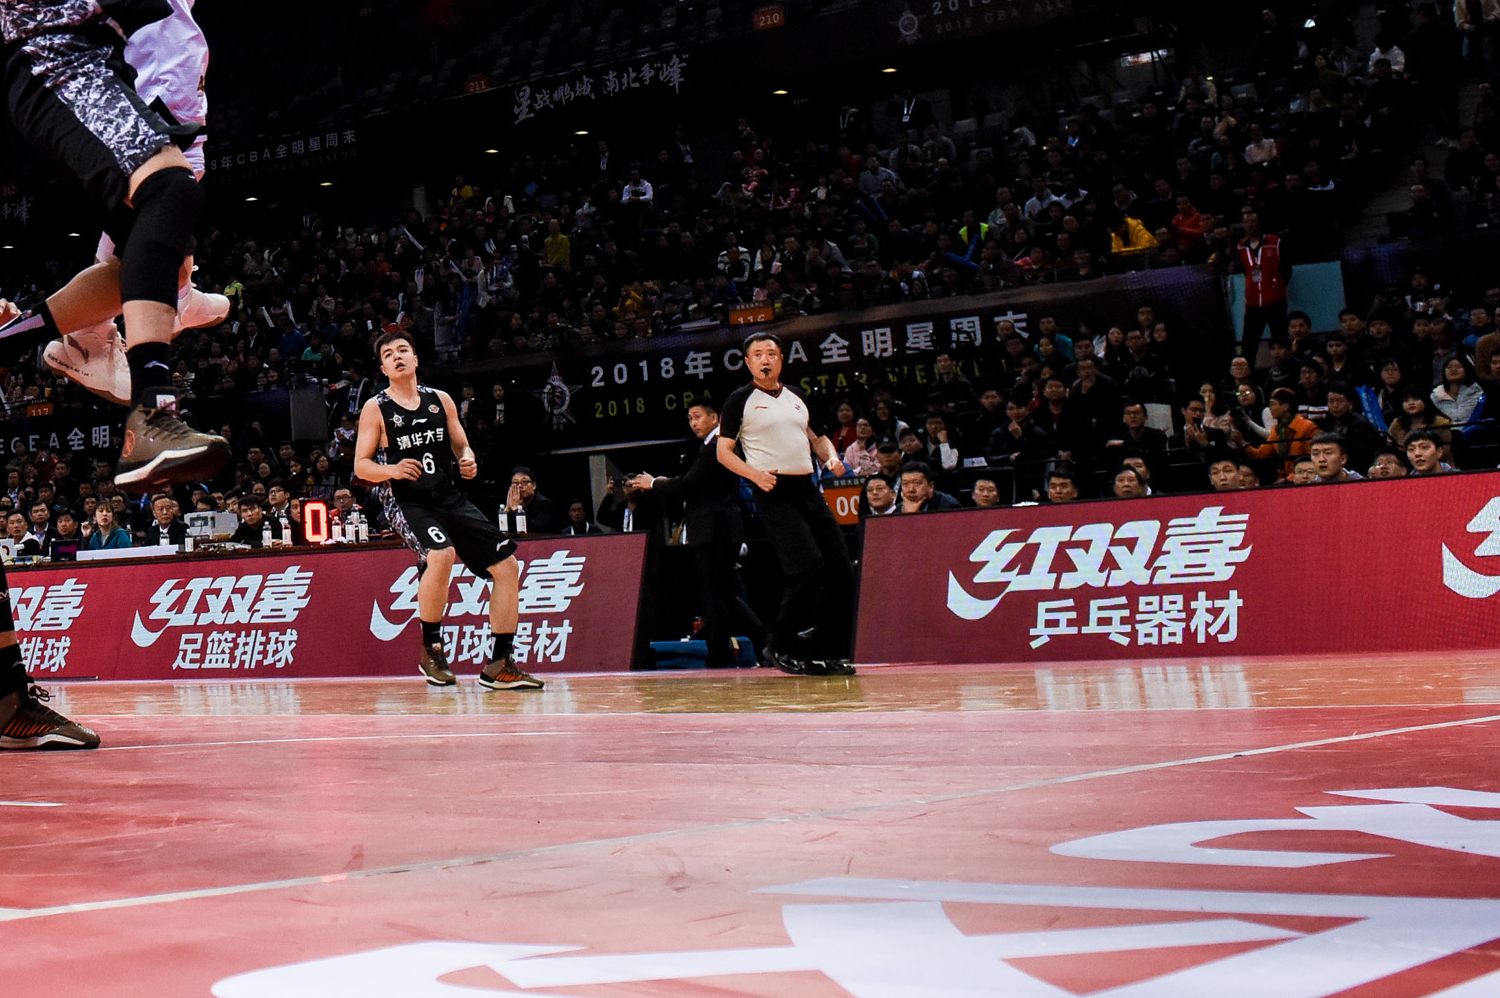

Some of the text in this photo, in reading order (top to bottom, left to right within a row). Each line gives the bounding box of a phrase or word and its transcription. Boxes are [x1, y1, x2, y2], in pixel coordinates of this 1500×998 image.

[758, 12, 780, 26] 210
[469, 80, 486, 92] 211
[590, 310, 1030, 388] 2018年CA全明星周末
[31, 407, 49, 417] 117
[594, 397, 645, 418] 2018
[422, 452, 436, 474] 6
[427, 526, 447, 544] 6
[947, 506, 1253, 620] 红双喜
[130, 565, 314, 647] 红双喜
[1029, 590, 1244, 649] 乒乓器材
[172, 629, 299, 670] 足篮排球
